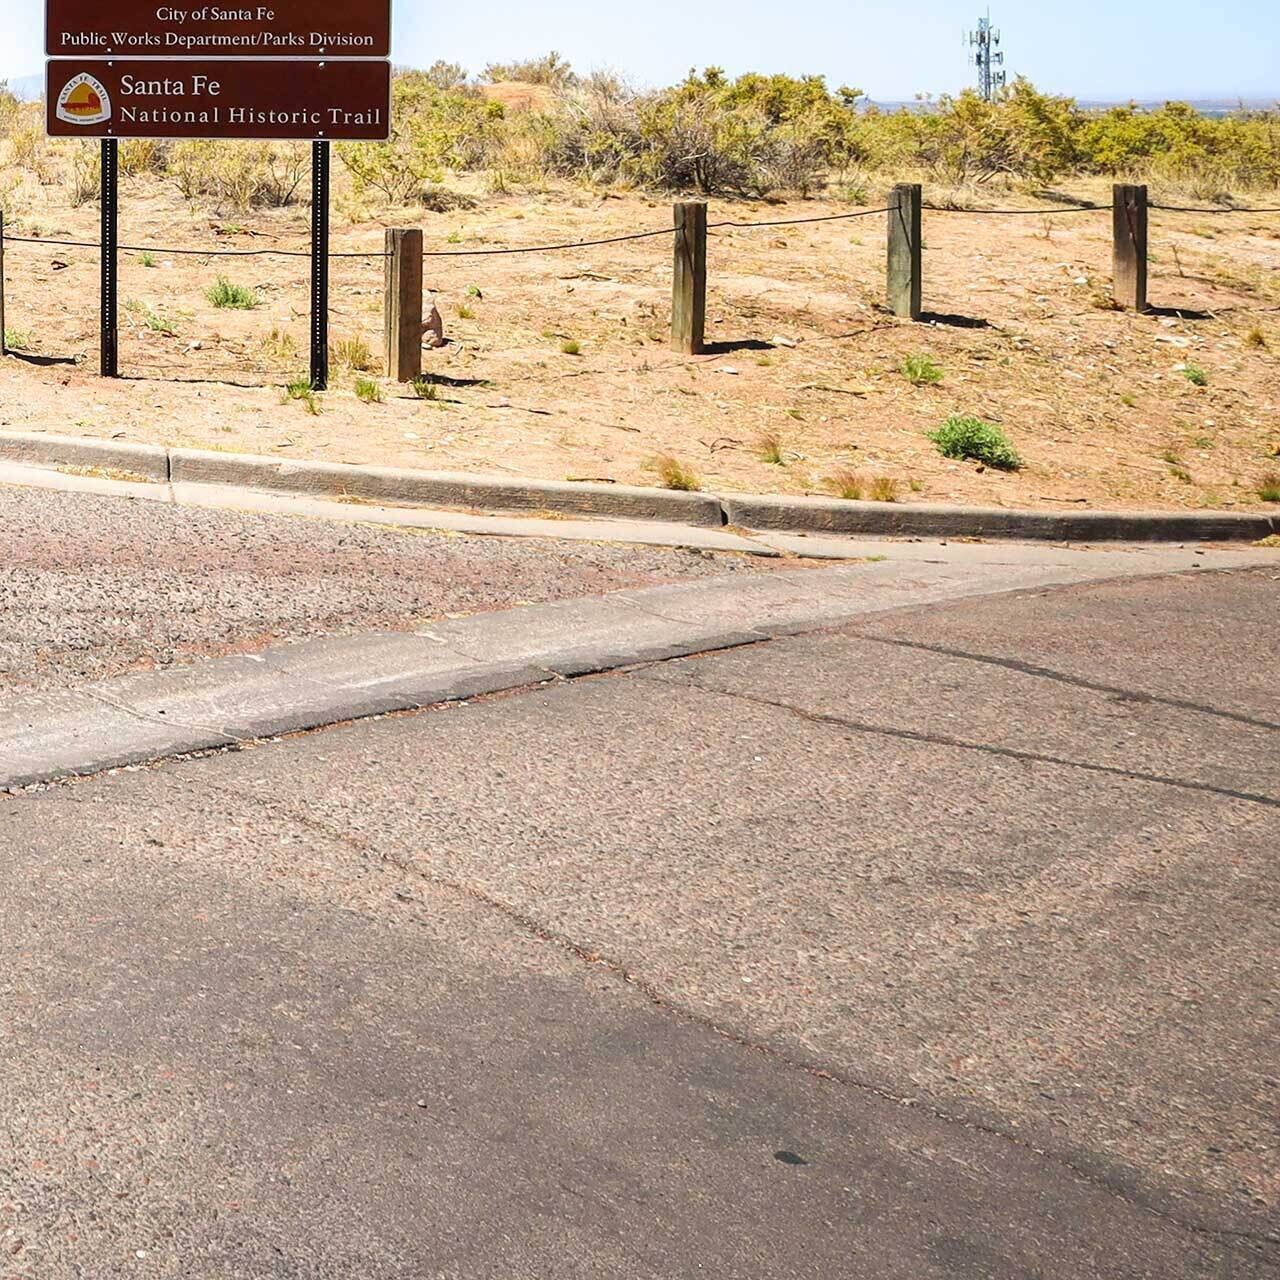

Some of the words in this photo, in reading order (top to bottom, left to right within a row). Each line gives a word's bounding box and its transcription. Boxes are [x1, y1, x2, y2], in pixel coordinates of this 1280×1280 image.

[156, 7, 188, 25] City
[191, 6, 209, 21] of
[210, 7, 252, 21] Santa
[256, 7, 275, 21] Fe
[60, 32, 108, 46] Public
[110, 32, 161, 46] Works
[165, 31, 305, 49] Department/Parks
[309, 32, 374, 46] Division
[120, 74, 185, 96] Santa
[191, 75, 221, 96] Fe
[119, 106, 219, 124] National
[228, 106, 321, 124] Historic
[327, 107, 381, 125] Trail
